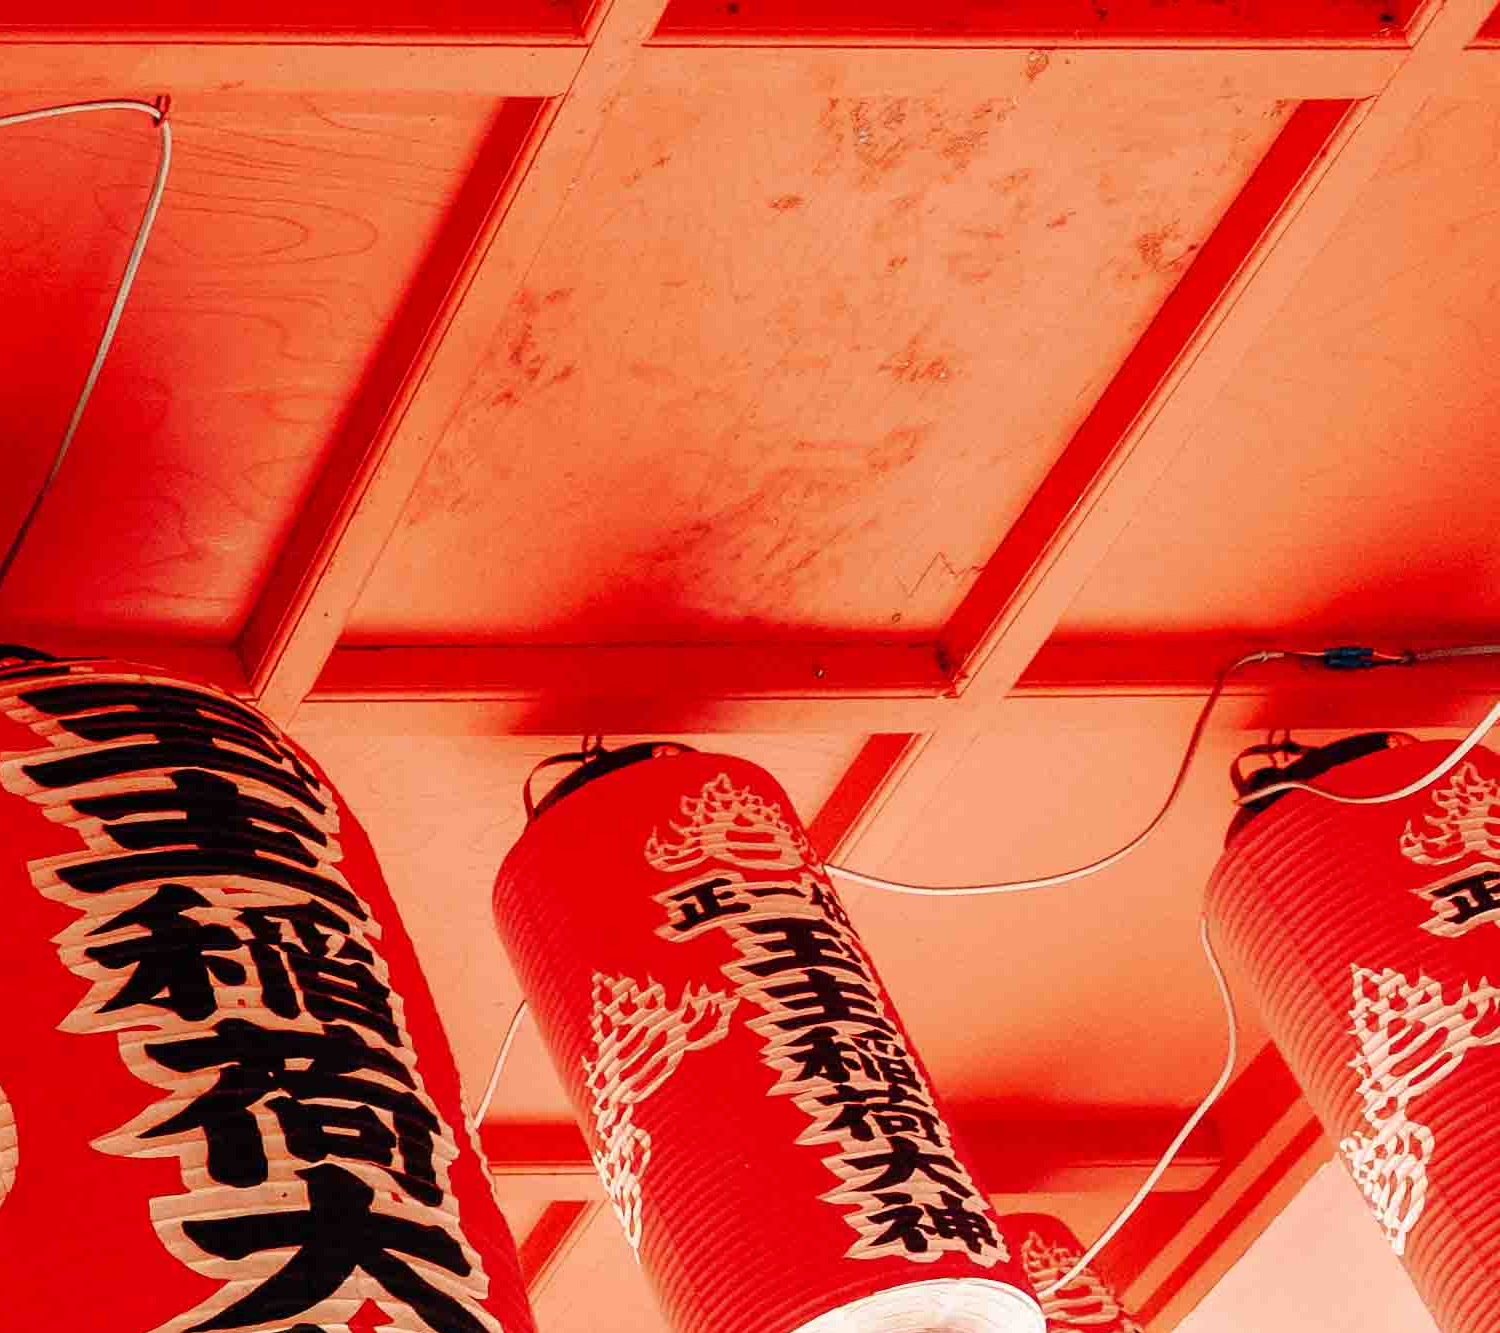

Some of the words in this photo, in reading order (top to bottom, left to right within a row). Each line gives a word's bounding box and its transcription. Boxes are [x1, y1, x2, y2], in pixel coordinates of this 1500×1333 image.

[740, 914, 1000, 1258] 玉主稲荷大神
